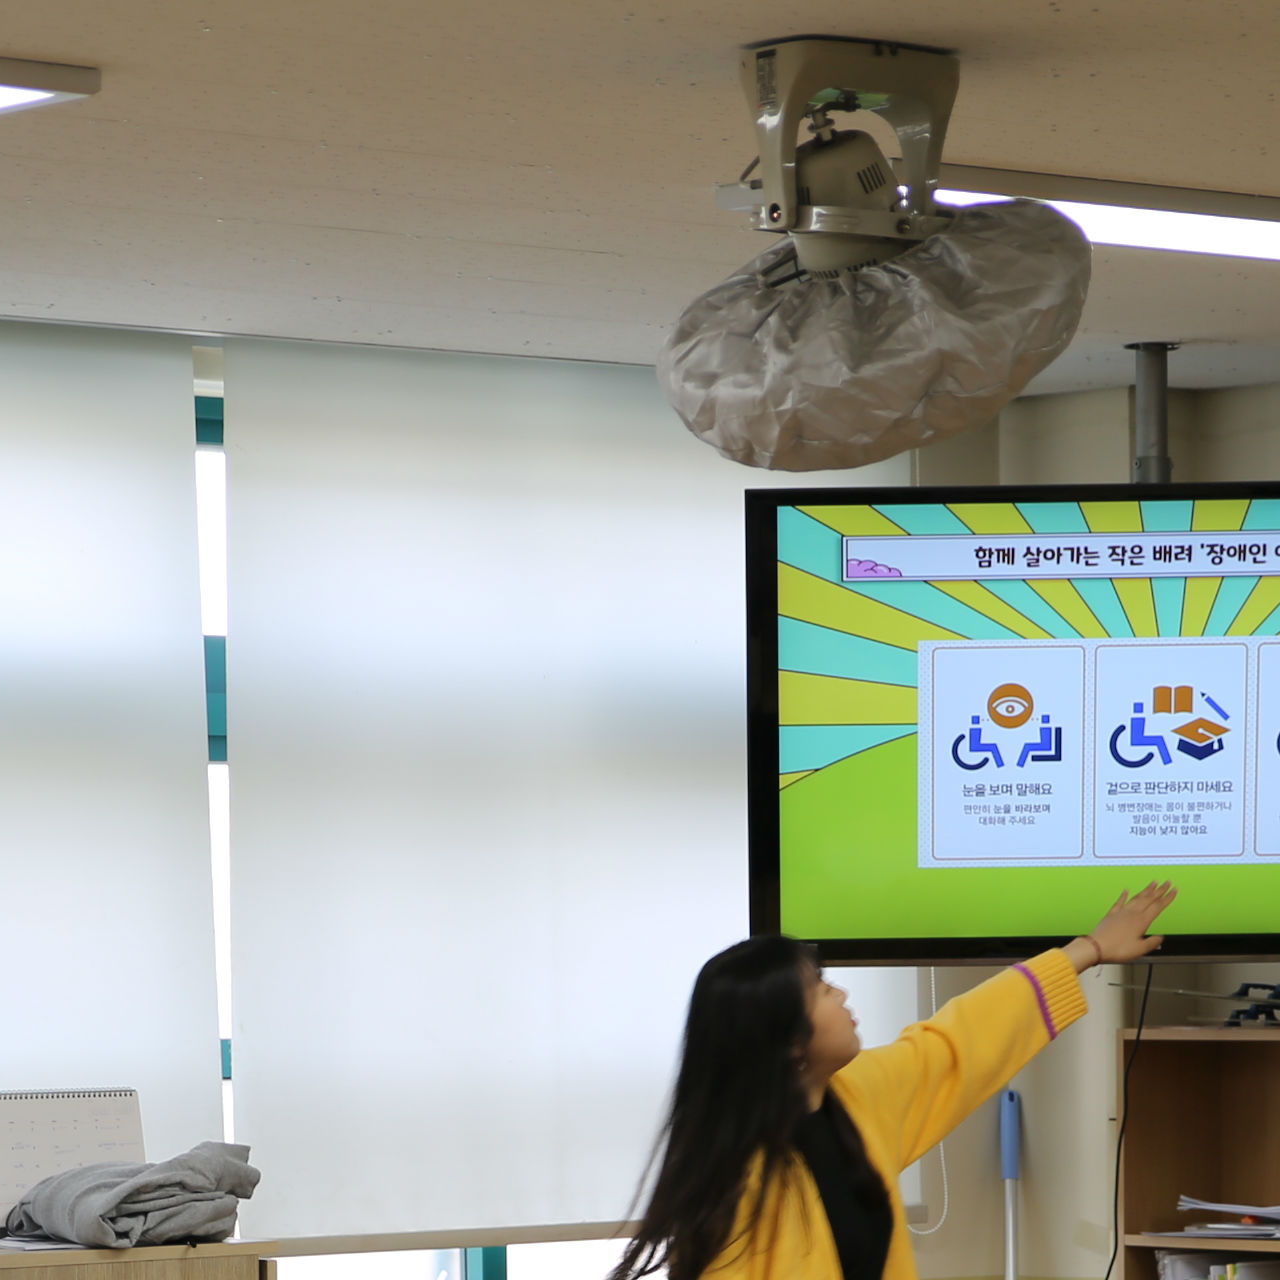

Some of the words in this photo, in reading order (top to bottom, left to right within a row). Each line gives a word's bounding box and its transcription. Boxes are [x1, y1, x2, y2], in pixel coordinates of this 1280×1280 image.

[974, 545, 1015, 568] 함께
[1022, 545, 1101, 568] 살아가는
[1107, 544, 1146, 567] 작은
[1152, 544, 1193, 564] 배려
[962, 783, 986, 797] 눈을
[988, 783, 1013, 796] 보며
[1016, 782, 1053, 797] 말해요
[1106, 781, 1142, 795] 겉으로
[1144, 781, 1194, 795] 판단하지
[1197, 780, 1233, 793] 마세요
